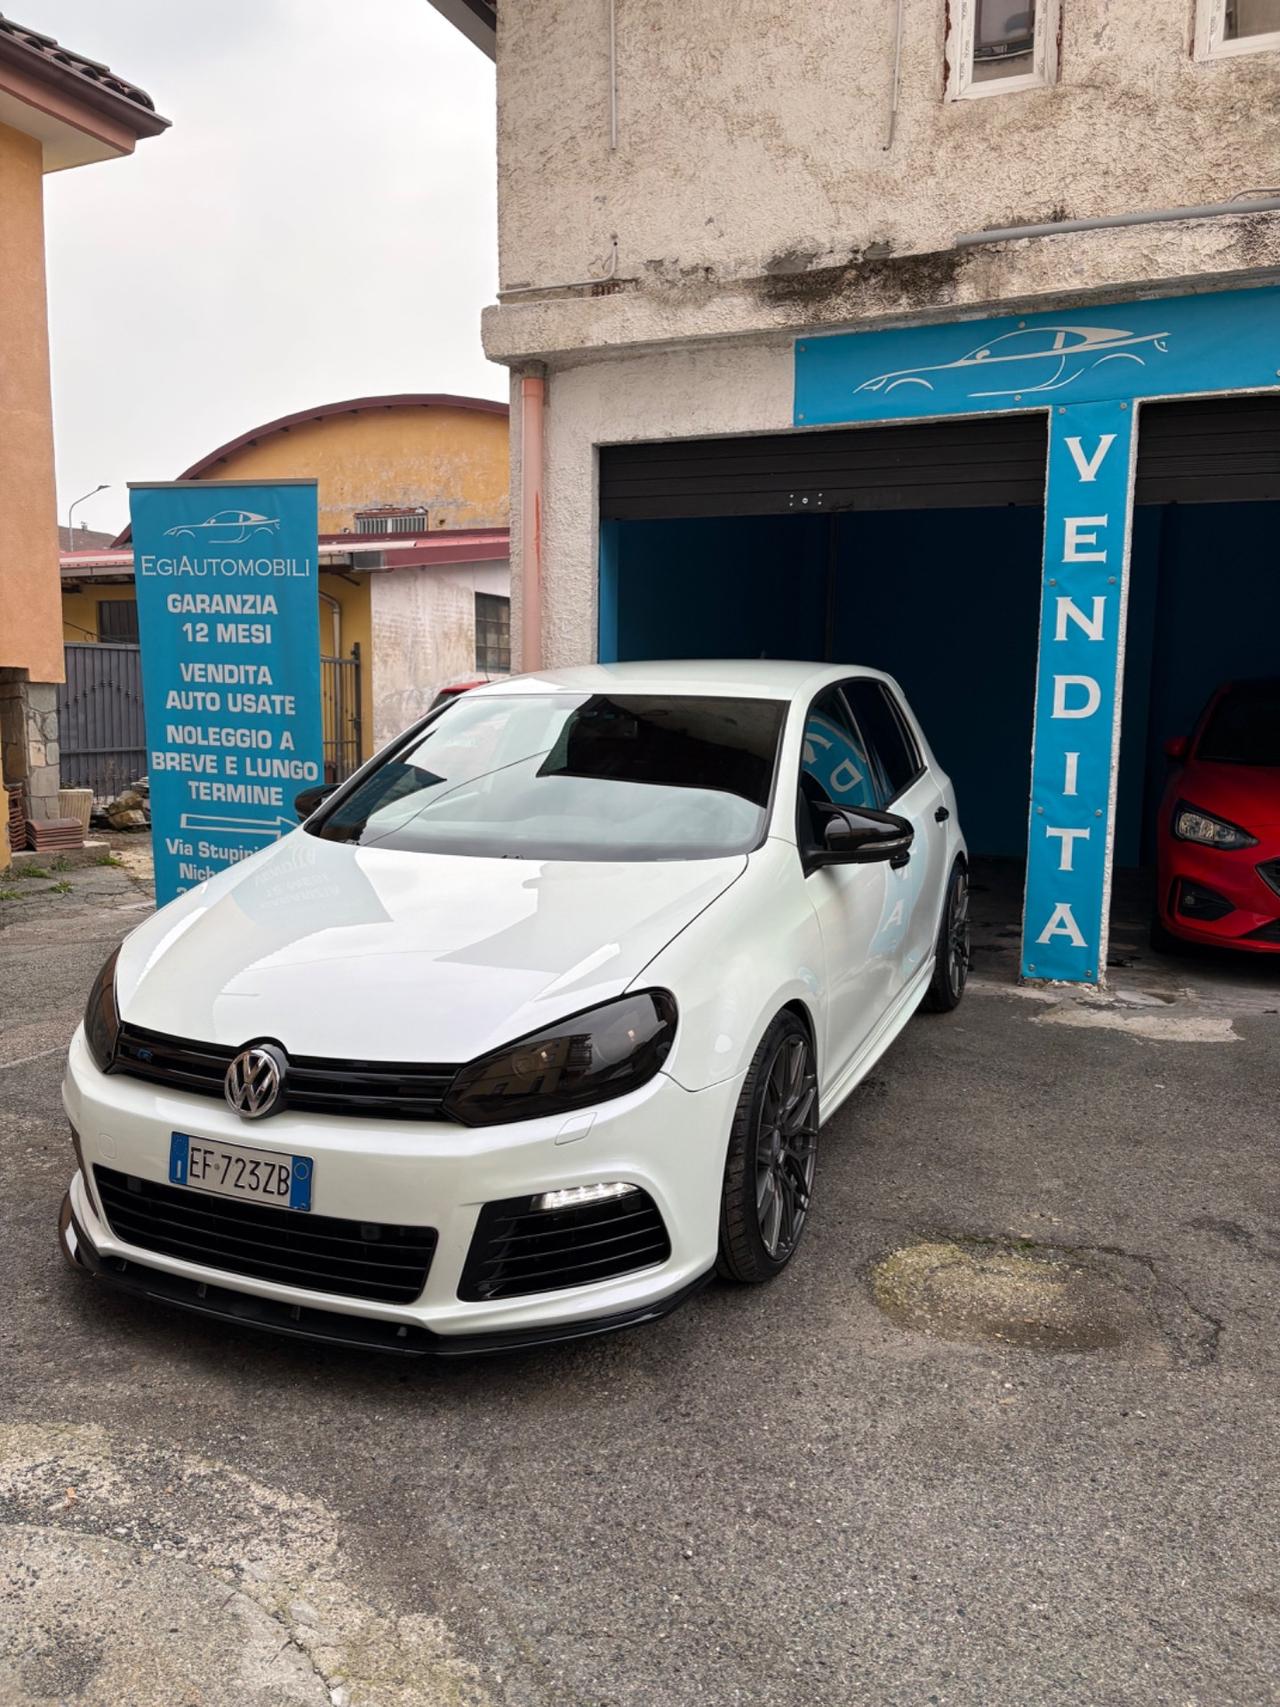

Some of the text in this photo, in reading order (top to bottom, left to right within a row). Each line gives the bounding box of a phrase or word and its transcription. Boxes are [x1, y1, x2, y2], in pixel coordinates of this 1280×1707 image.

[166, 593, 279, 615] GARANZIA
[182, 622, 272, 644] 12 MESI
[180, 663, 273, 686] VENDITA
[165, 690, 296, 716] AUTO USATE
[1035, 433, 1118, 948] VENDITA
[166, 724, 295, 751] NOLEGGIO A
[151, 751, 319, 781] BREVE E LUNGO
[187, 780, 283, 806] TERMINE
[165, 838, 193, 857] Via
